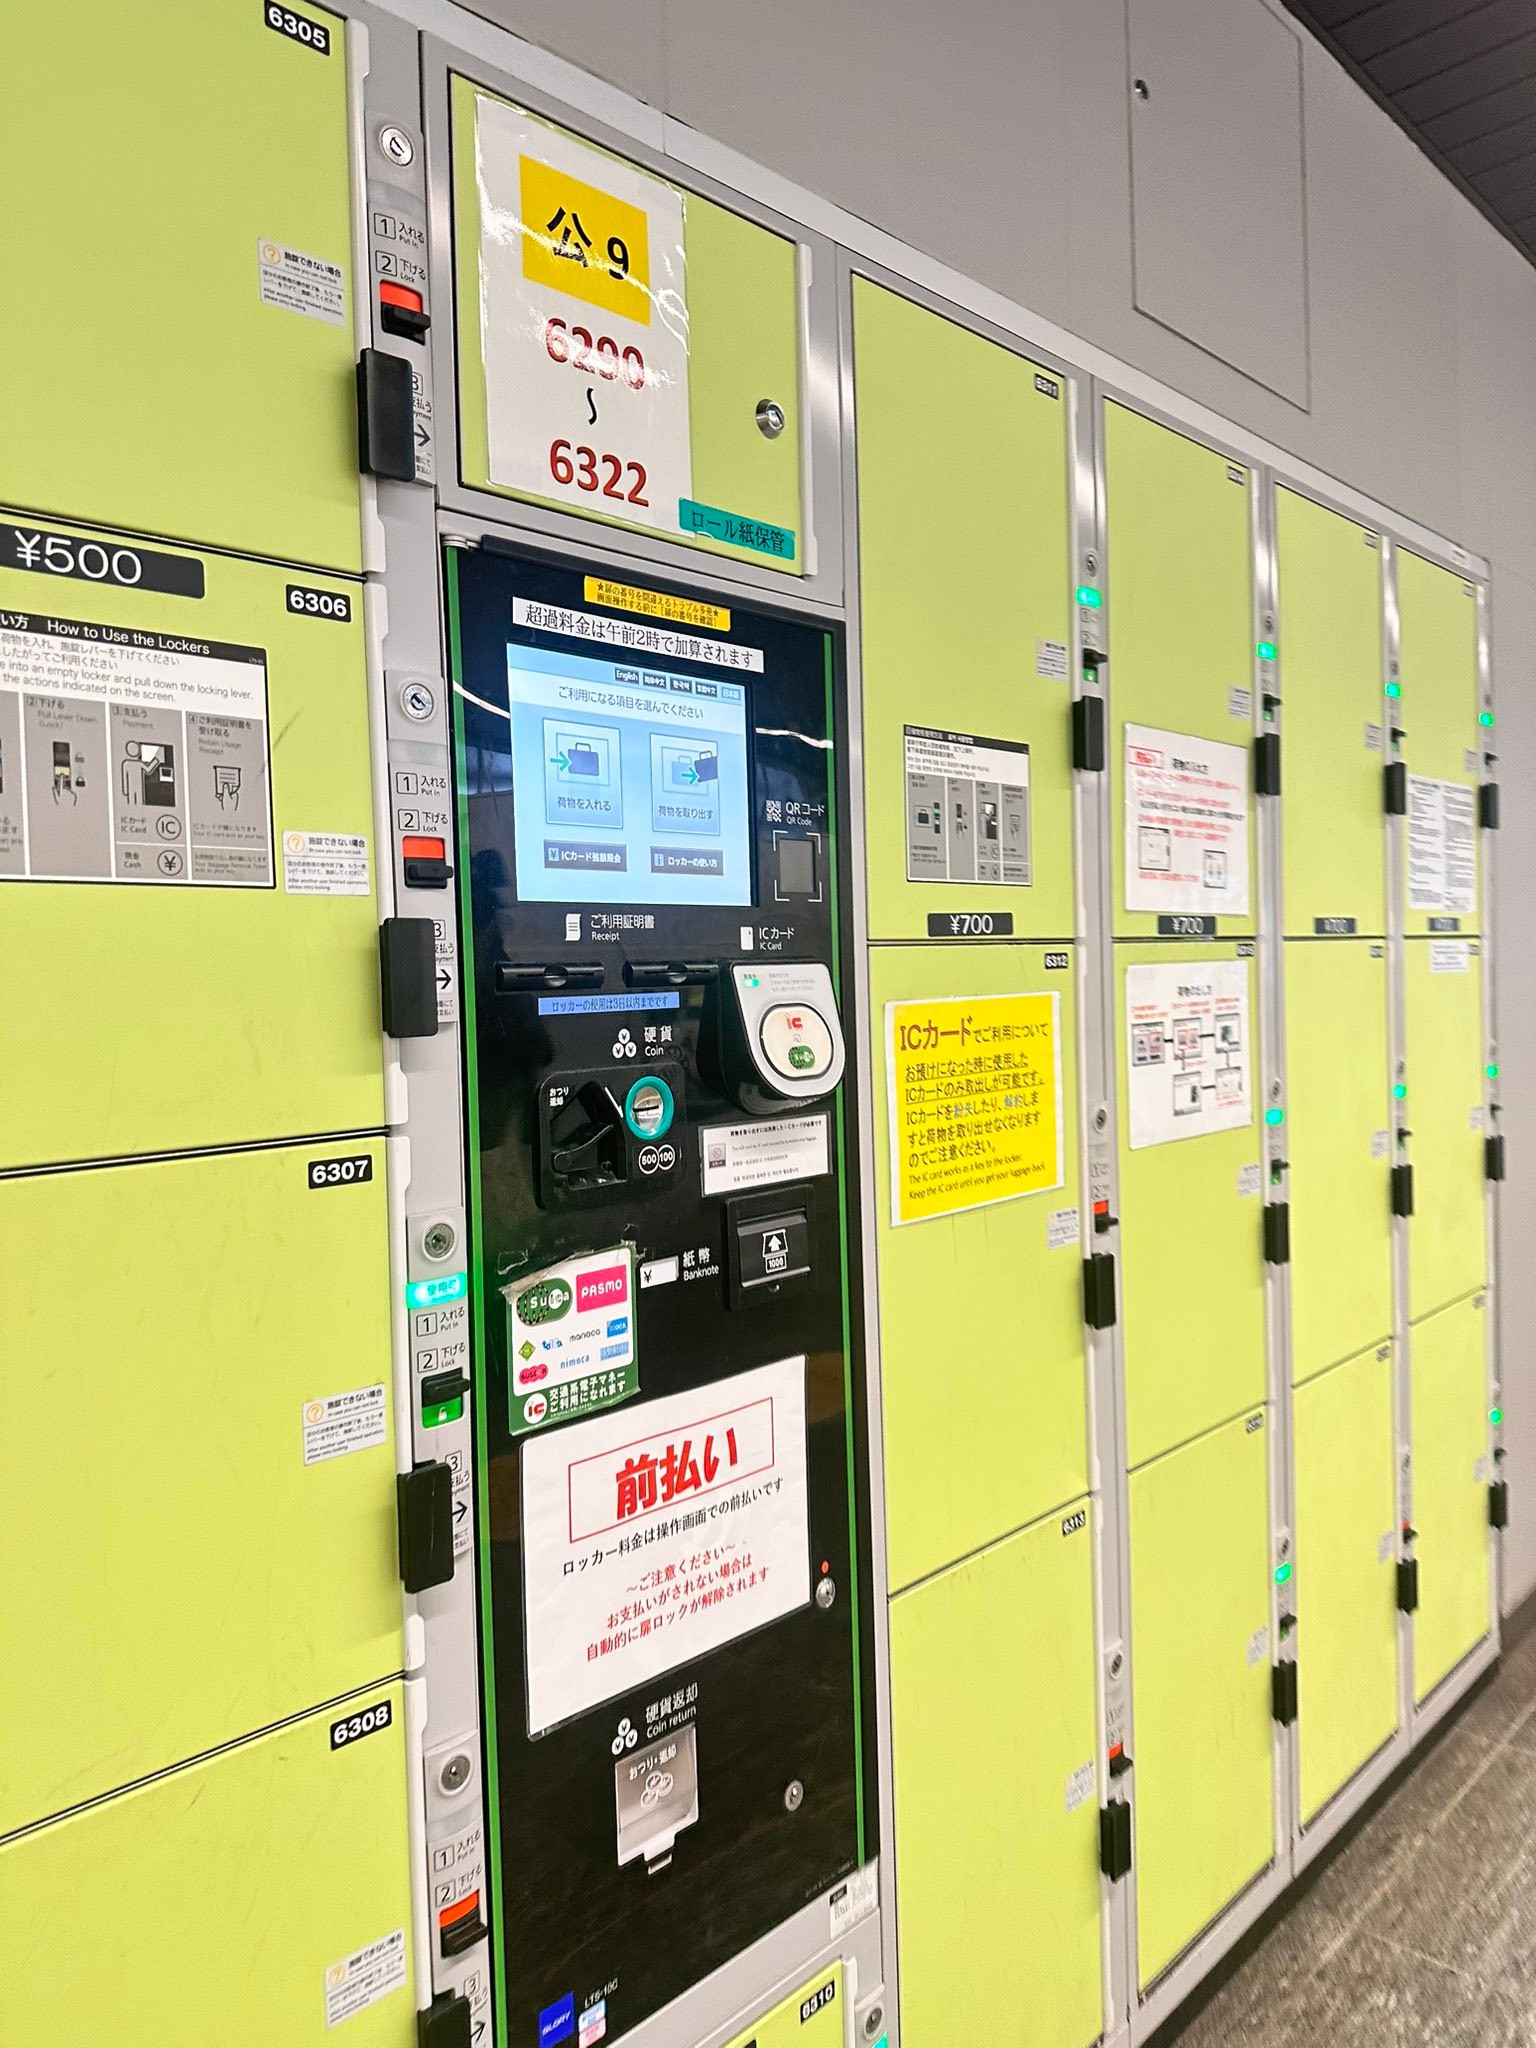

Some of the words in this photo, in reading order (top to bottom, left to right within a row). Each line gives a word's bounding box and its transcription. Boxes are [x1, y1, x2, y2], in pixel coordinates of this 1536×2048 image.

[268, 5, 327, 50] 6305
[381, 219, 388, 234] 1
[399, 222, 425, 243] 入れる
[382, 255, 392, 272] 2
[400, 259, 427, 280] 下げる
[545, 316, 646, 390] 6290
[549, 439, 650, 508] 6322
[691, 508, 786, 554] ロール紙保管
[16, 531, 143, 585] ¥500
[291, 590, 347, 618] 6306
[47, 620, 79, 636] How
[83, 625, 98, 639] to
[102, 628, 129, 644] Use
[133, 633, 155, 647] the
[159, 636, 211, 655] Lockers
[525, 604, 754, 668] 超過料金は午前2時で加算されます
[3, 673, 21, 683] the
[23, 675, 60, 689] actions
[62, 679, 107, 695] indicated
[110, 686, 123, 696] on
[125, 686, 140, 698] the
[9, 662, 29, 672] into
[32, 666, 45, 674] an
[47, 665, 79, 681] empty
[81, 669, 111, 682] locker
[114, 674, 132, 685] and
[134, 676, 151, 688] pull
[154, 679, 178, 691] down
[180, 681, 195, 693] the
[197, 682, 229, 698] locking
[616, 670, 639, 683] English
[558, 685, 704, 720] ご利用になる項目を選んでください
[722, 689, 740, 700] 日本語
[403, 776, 410, 791] 1
[421, 775, 446, 789] 入れる
[557, 796, 611, 812] 荷物を入れる
[658, 804, 713, 821] 荷物を取り出す
[404, 812, 415, 828] 2
[422, 811, 448, 825] 下げる
[667, 856, 719, 869] ロッカーの使い方
[590, 913, 656, 930] ご利用証明書
[950, 914, 994, 935] ¥700
[1172, 916, 1204, 934] ¥700
[591, 931, 620, 943] Receipt
[767, 940, 782, 951] Card
[552, 996, 669, 1013] ロッカーの使用は3日以内までです
[644, 1045, 665, 1057] Coin
[905, 1051, 1029, 1082] お預けになった時に使用した
[550, 1086, 569, 1097] おつり
[905, 1069, 1045, 1103] ICカードのみ取出しが可能です。
[907, 1110, 1041, 1148] すと荷物を取り出せなくなります
[642, 1153, 657, 1166] 500
[660, 1151, 674, 1162] 100
[909, 1140, 996, 1168] のでご注意ください。
[312, 1159, 369, 1184] 6307
[768, 1256, 784, 1268] 1000
[683, 1265, 720, 1282] Banknote
[581, 1279, 623, 1299] PASMO
[440, 1306, 465, 1323] 入れる
[423, 1317, 429, 1333] 1
[569, 1328, 601, 1343] manaca
[441, 1341, 466, 1359] 下げる
[423, 1353, 433, 1370] 2
[560, 1354, 590, 1370] nimoca
[549, 1370, 626, 1402] 交通系電子マネー
[550, 1380, 626, 1414] ご利用になれます
[616, 1427, 738, 1520] 前払い
[563, 1477, 784, 1576] ロッカー料金は操作画面での前払いです
[607, 1553, 753, 1629] お支払いがされない場合は
[587, 1566, 770, 1663] 自動的に扉ロックが解除されます
[645, 1682, 698, 1724] 硬貨返却
[333, 1705, 389, 1746] 6308
[646, 1720, 667, 1739] Coin
[669, 1705, 697, 1728] return
[458, 1863, 482, 1886] 下げる
[441, 1885, 451, 1905] 2
